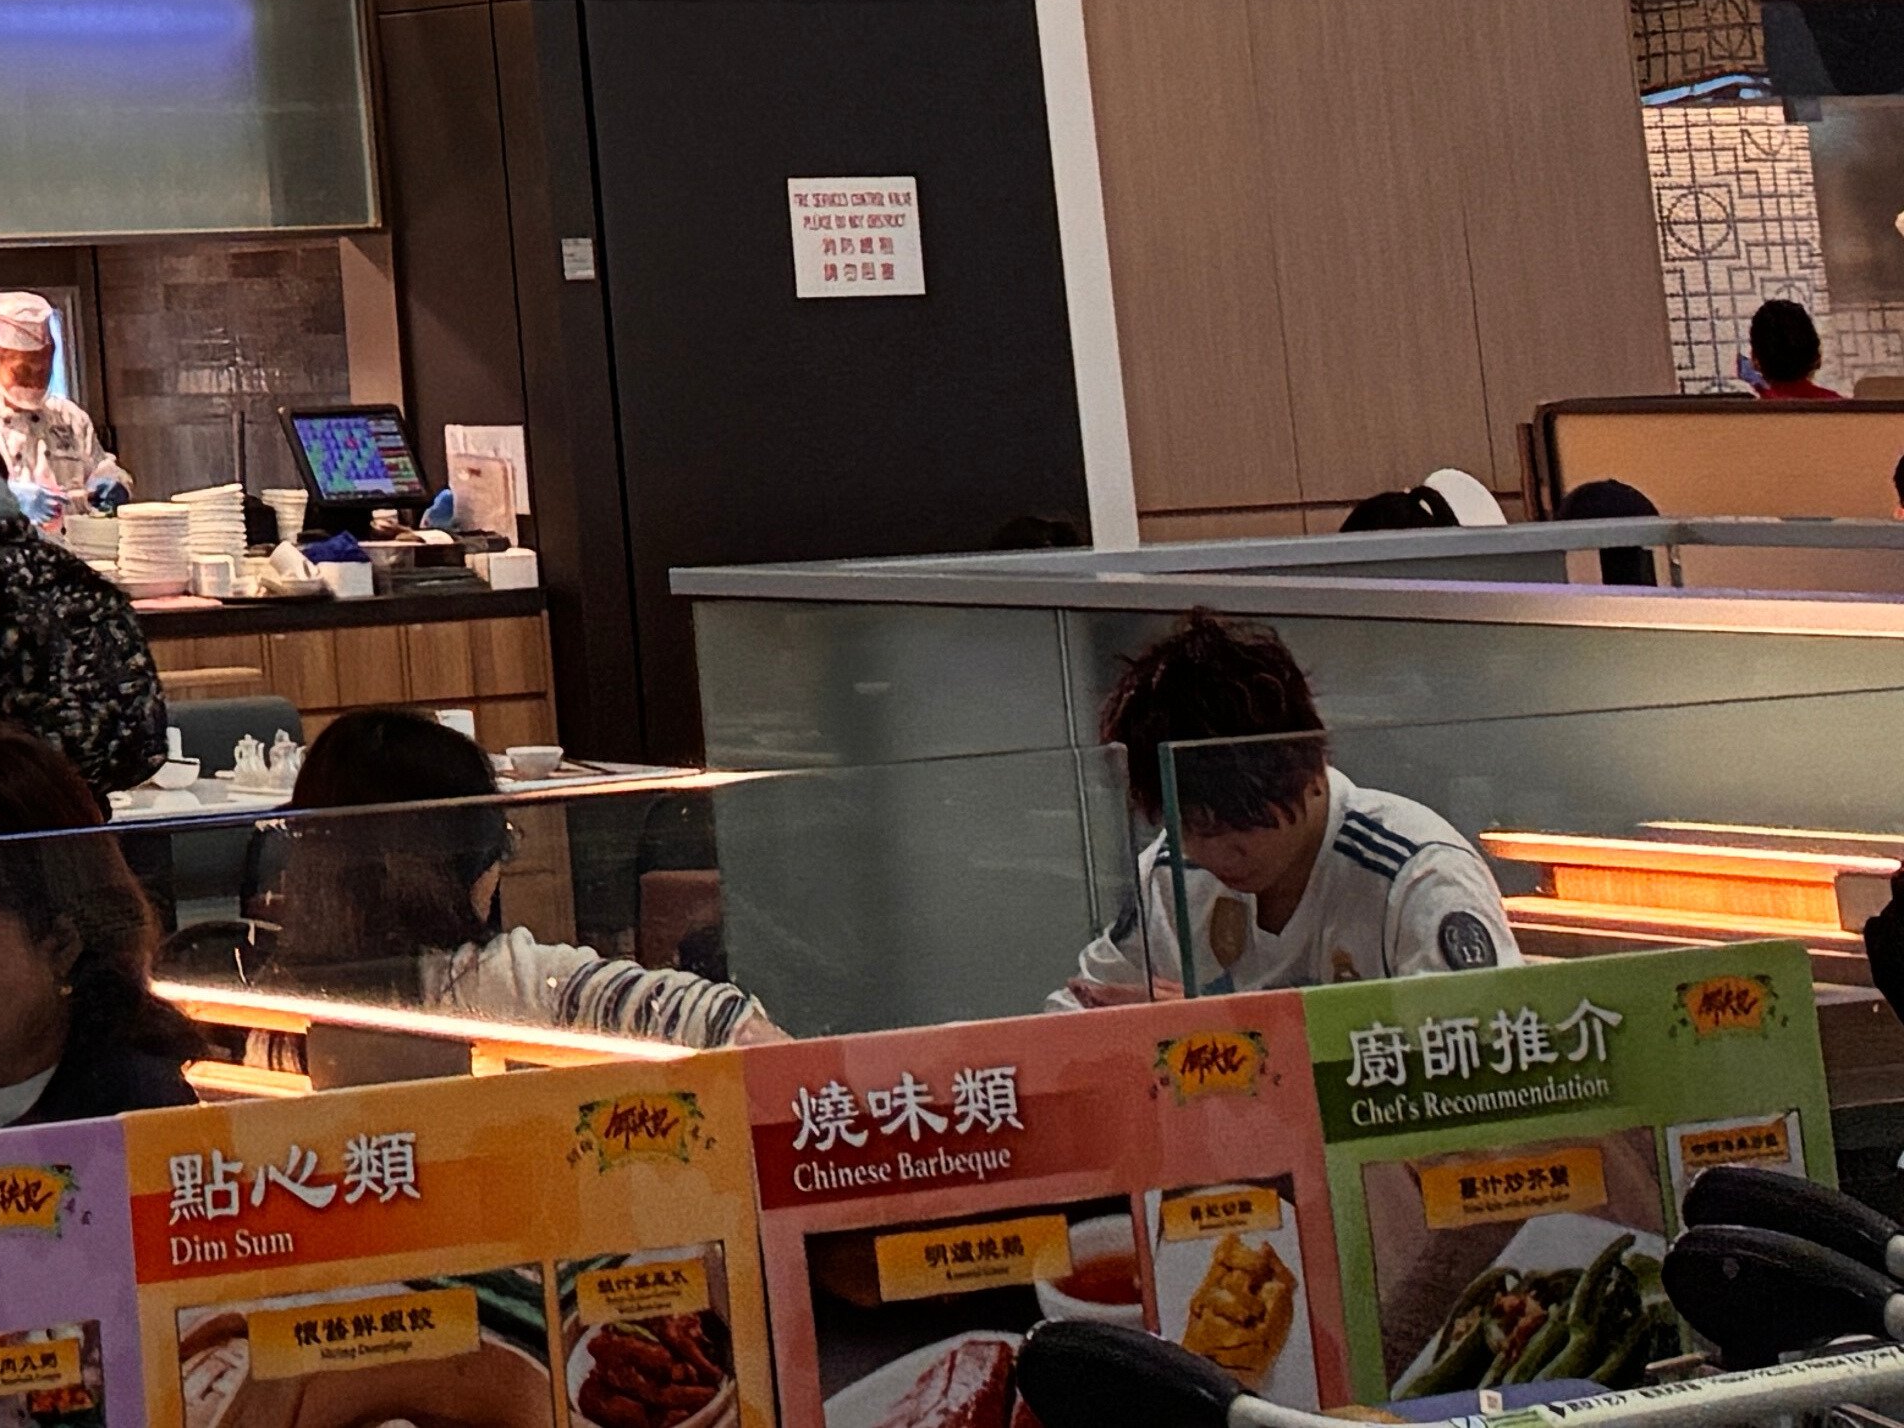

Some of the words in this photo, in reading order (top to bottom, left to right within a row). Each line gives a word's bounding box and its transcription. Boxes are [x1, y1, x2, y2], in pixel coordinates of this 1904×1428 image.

[1346, 998, 1623, 1087] 廚師推介
[792, 1066, 1025, 1151] 燒味類
[1351, 1094, 1419, 1127] Chef's
[1424, 1074, 1610, 1119] Recommendation
[169, 1131, 421, 1225] 點心類
[793, 1160, 892, 1192] Chinese
[898, 1147, 1011, 1180] Barbeque
[170, 1234, 228, 1266] Dim
[235, 1229, 294, 1258] Sum
